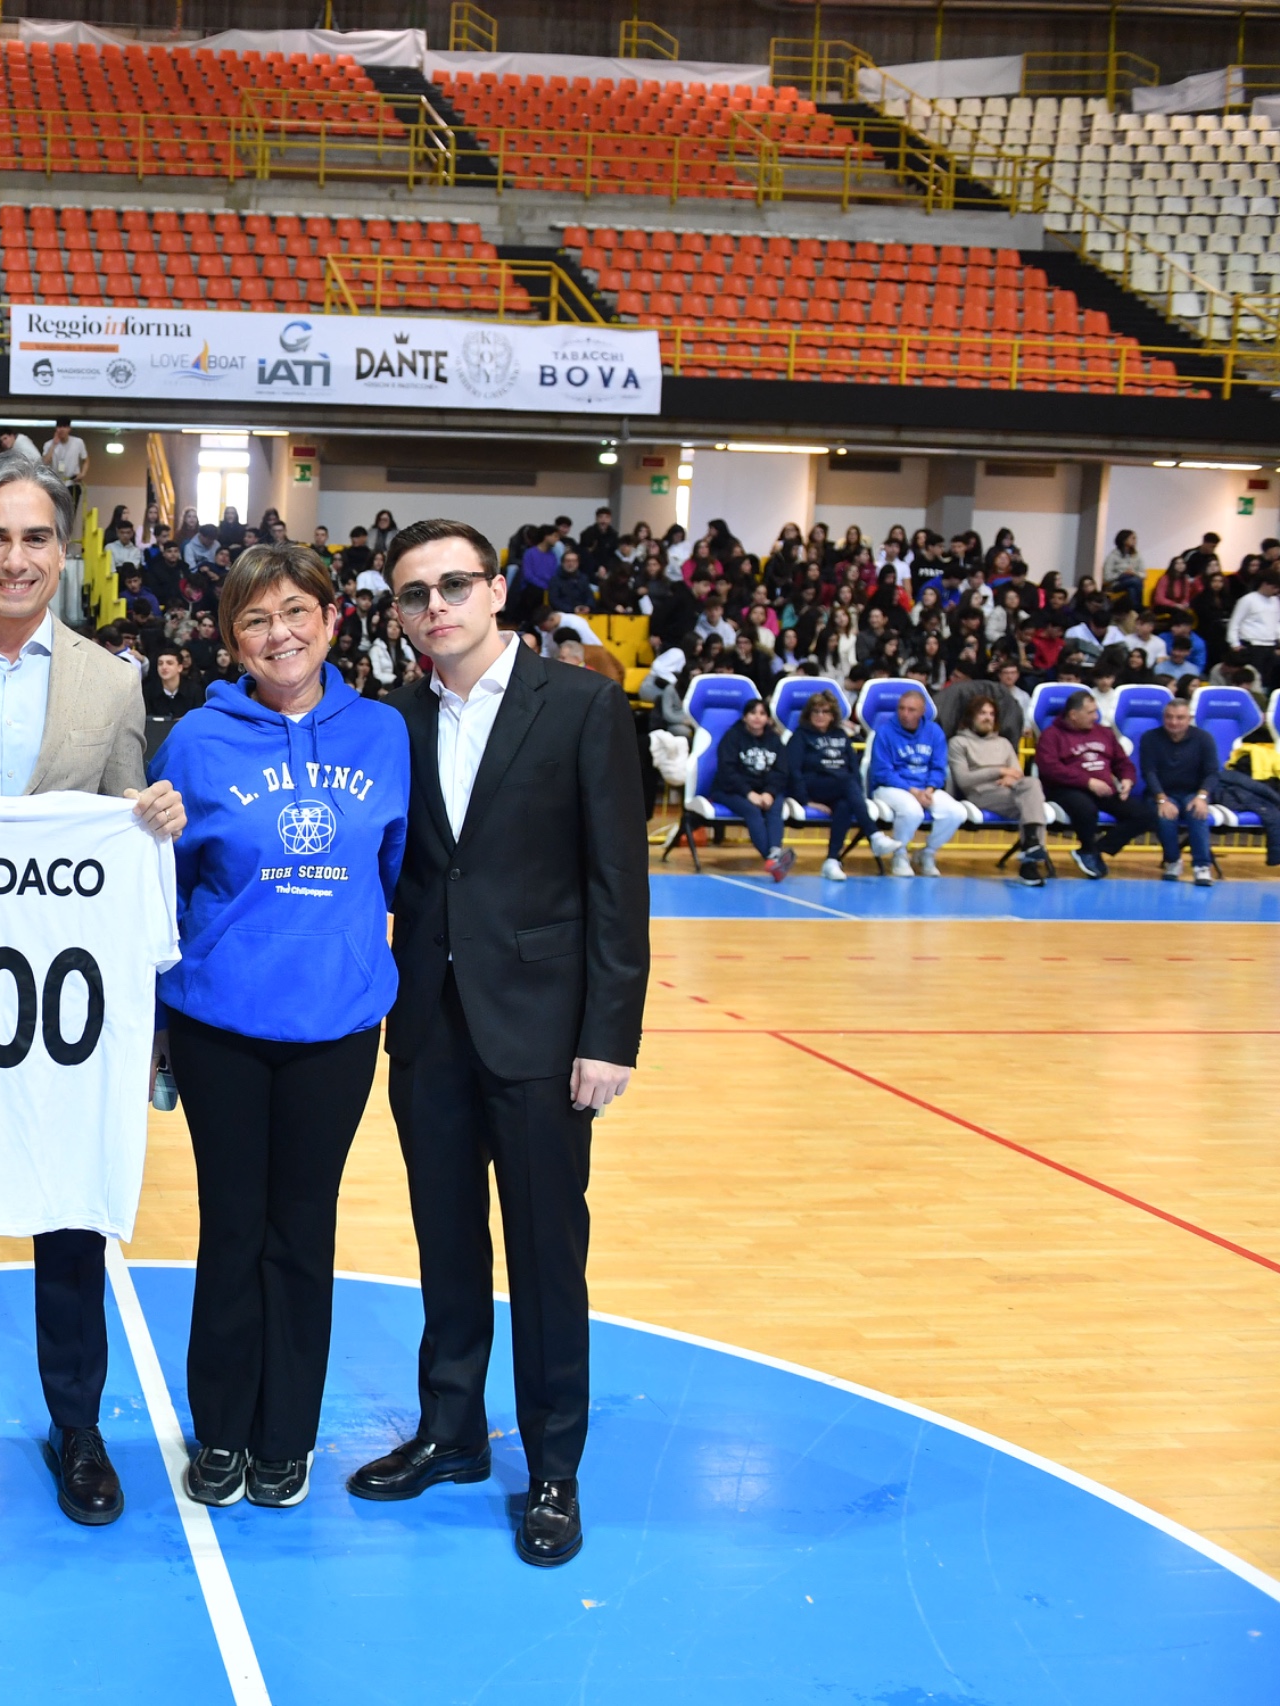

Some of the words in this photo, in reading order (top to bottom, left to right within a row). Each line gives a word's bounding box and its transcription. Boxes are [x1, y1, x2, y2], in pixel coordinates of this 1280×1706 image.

[149, 353, 189, 369] LOVE
[207, 355, 247, 370] BOAT
[355, 347, 448, 384] DANTE
[552, 350, 625, 362] TABACCHI
[539, 364, 641, 390] BOVA
[229, 784, 260, 806] L.
[262, 761, 299, 792] DA
[305, 761, 374, 801] VINCI
[260, 866, 293, 881] HIGH
[297, 865, 349, 881] SCHOOL
